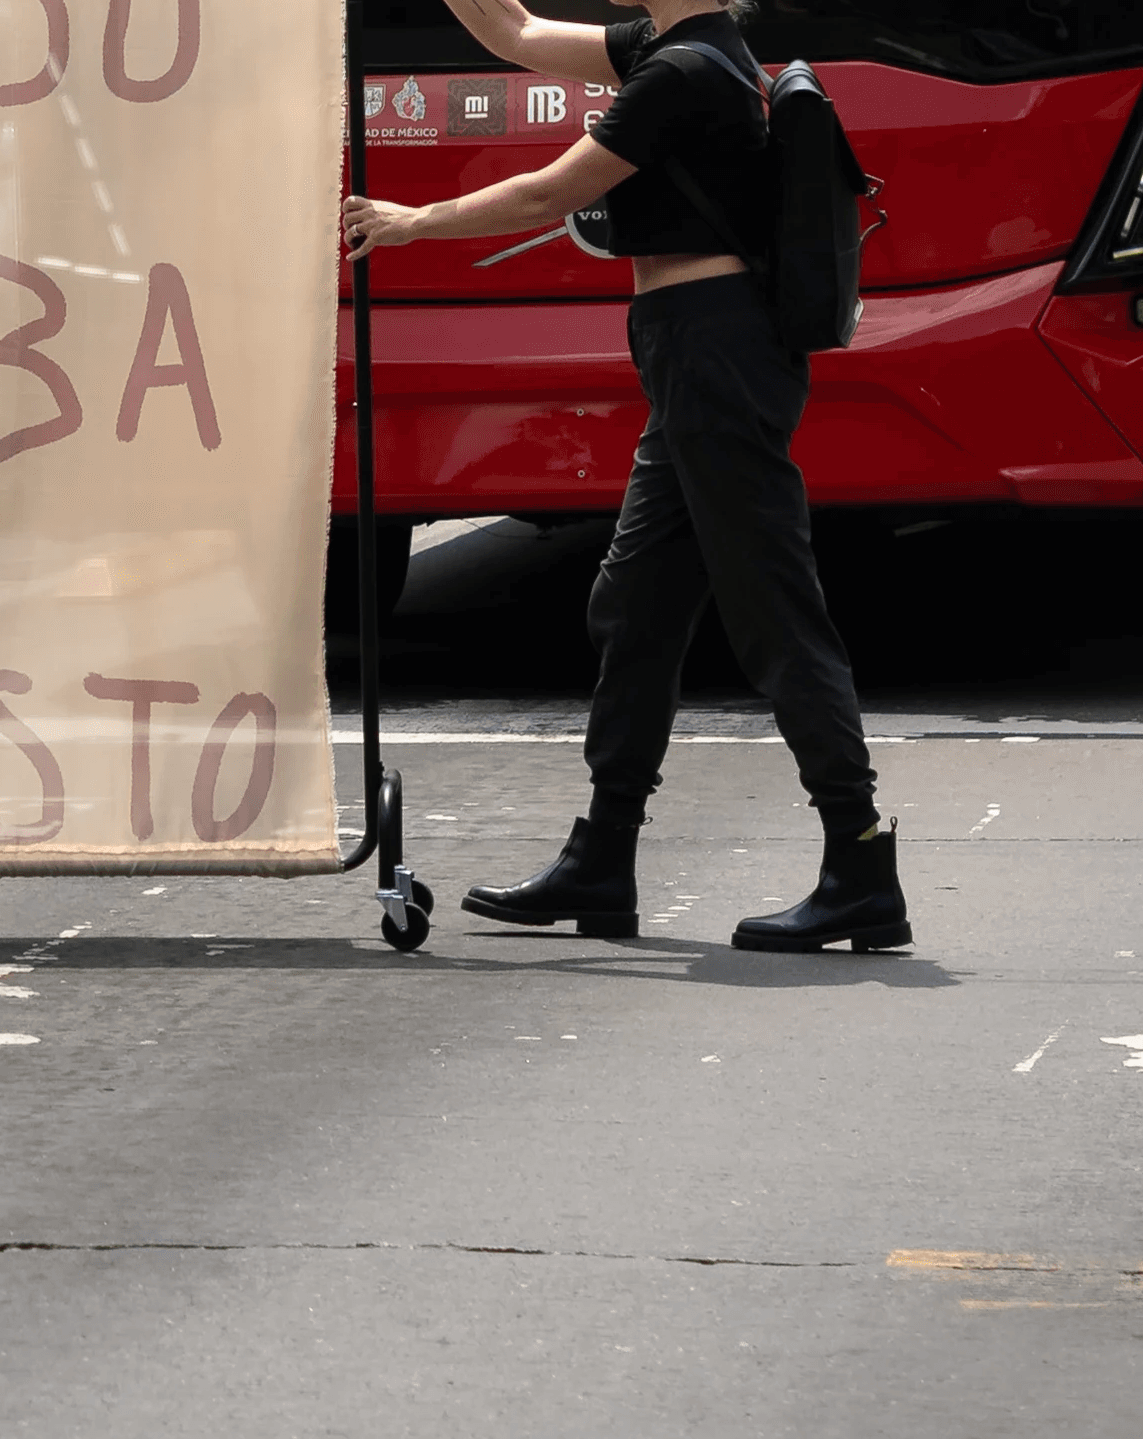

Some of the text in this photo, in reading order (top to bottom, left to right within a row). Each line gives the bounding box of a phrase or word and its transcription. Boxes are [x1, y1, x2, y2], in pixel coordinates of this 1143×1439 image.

[527, 85, 566, 123] MB
[381, 128, 396, 137] DE
[398, 126, 438, 137] MÉXICO
